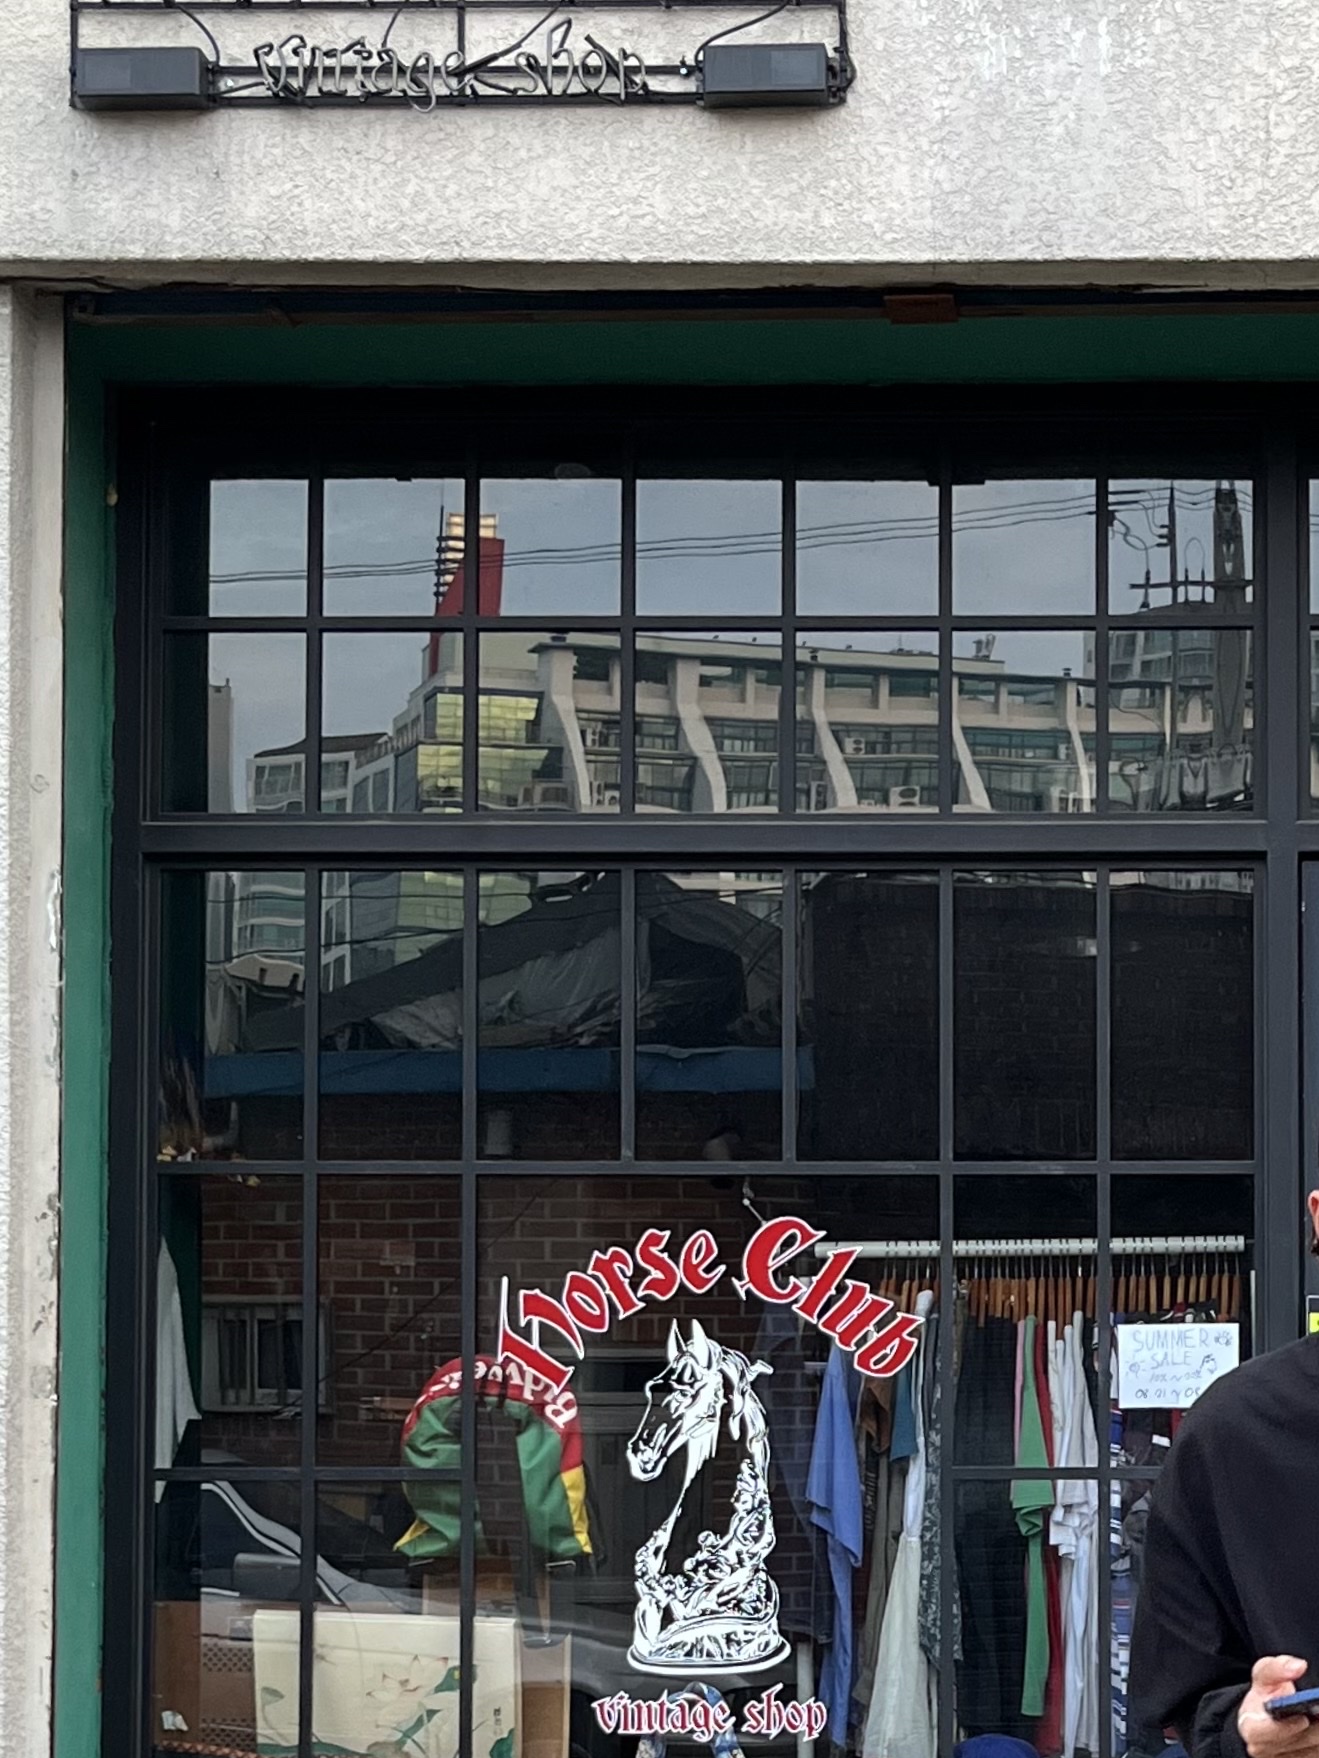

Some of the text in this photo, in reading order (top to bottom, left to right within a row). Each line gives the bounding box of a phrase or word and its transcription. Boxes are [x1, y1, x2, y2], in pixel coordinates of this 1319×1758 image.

[496, 1216, 925, 1393] Horse Club
[1132, 1328, 1209, 1353] SUMMER
[1150, 1350, 1192, 1370] SALE
[742, 1684, 827, 1742] shop
